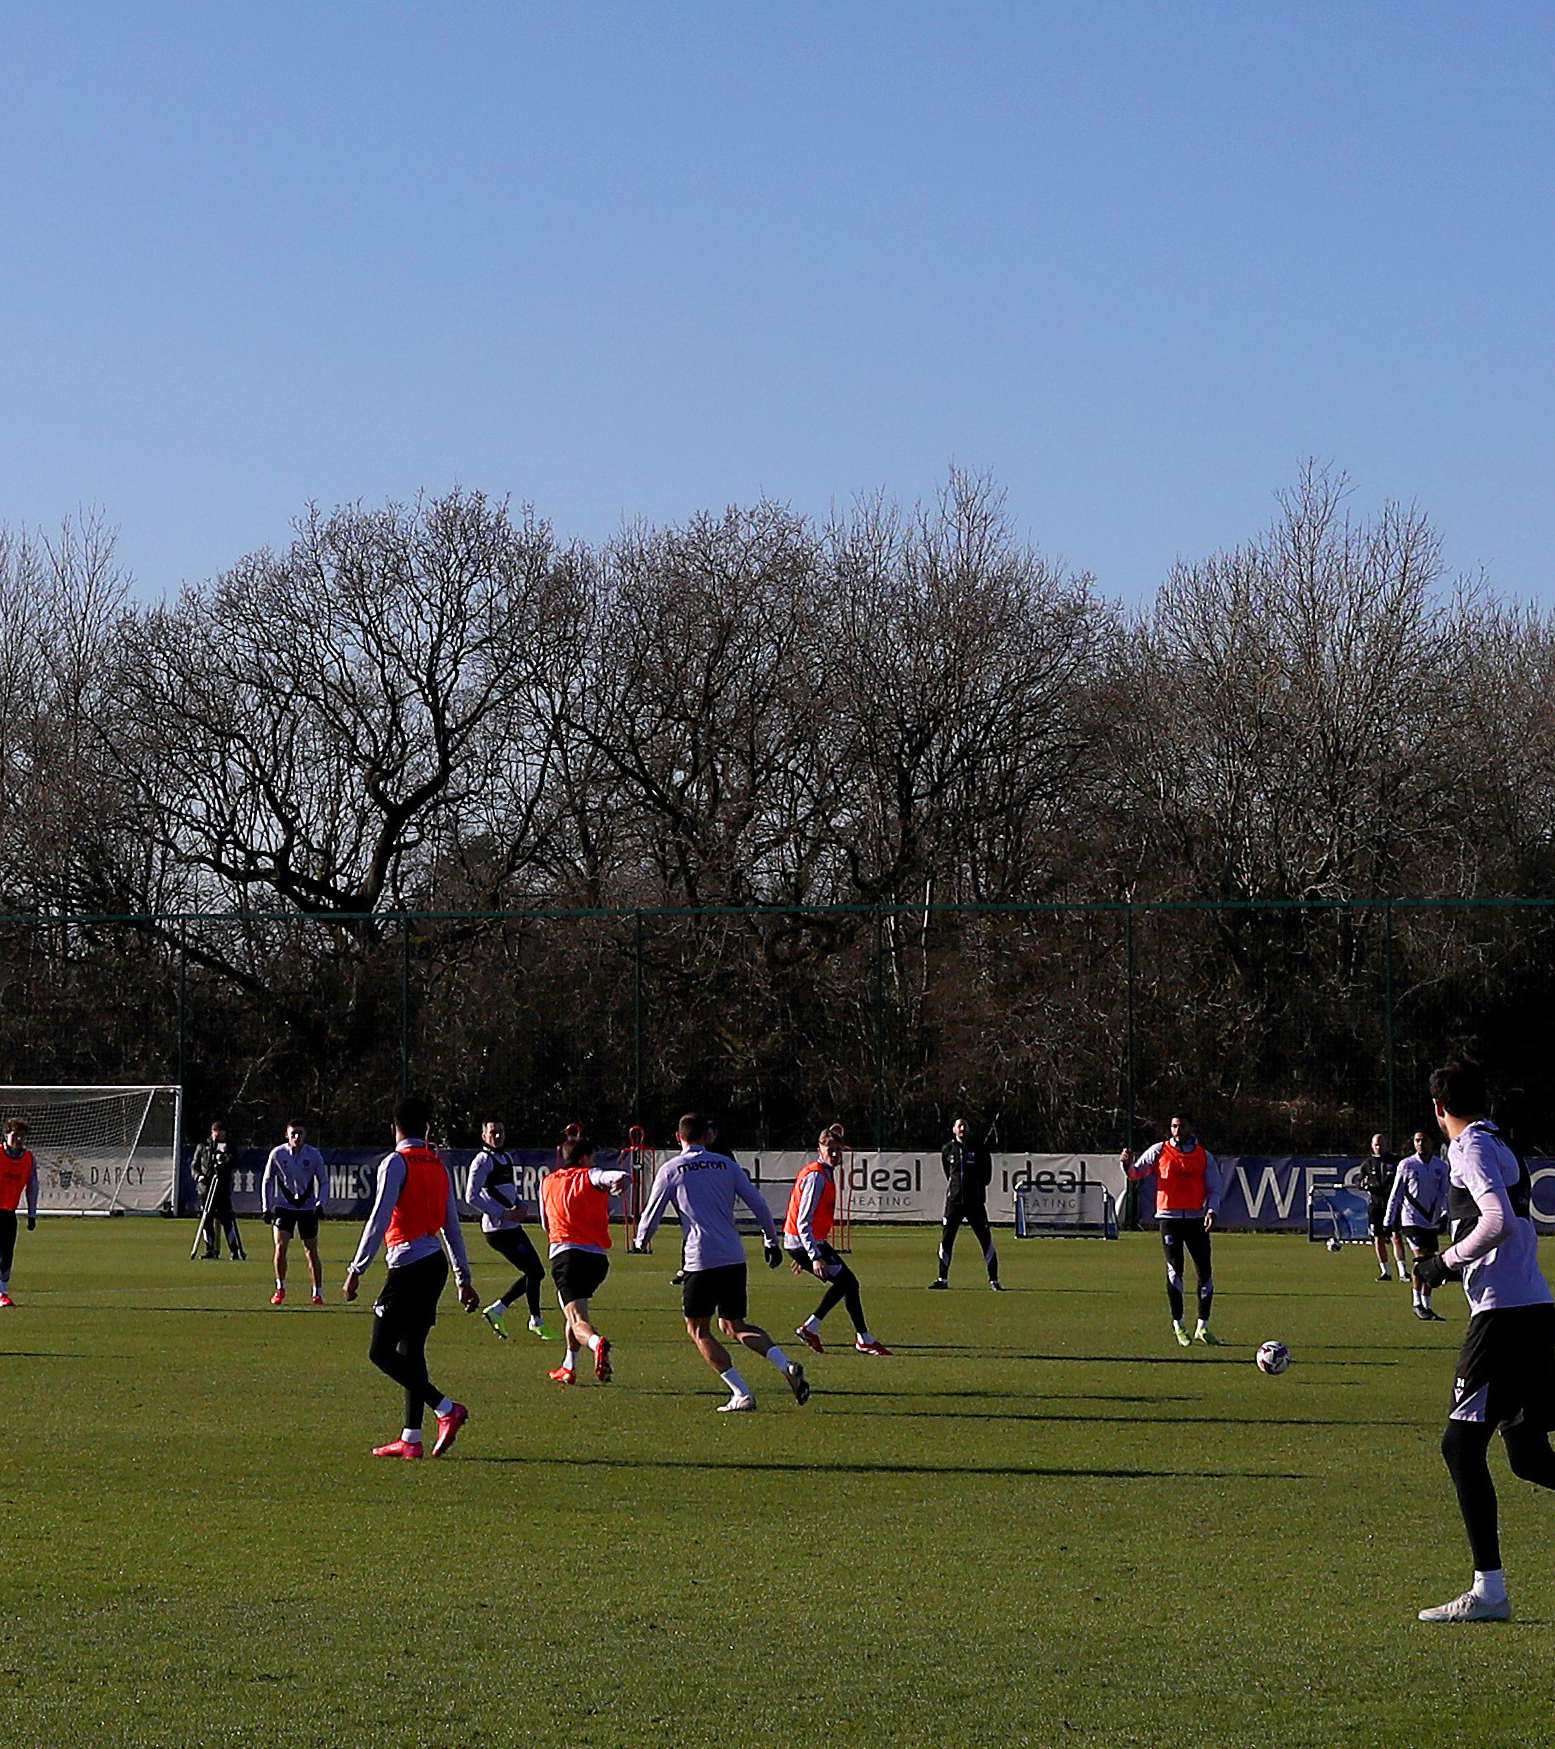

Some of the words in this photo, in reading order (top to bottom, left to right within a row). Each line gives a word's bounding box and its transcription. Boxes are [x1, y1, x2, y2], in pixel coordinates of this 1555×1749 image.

[677, 1159, 728, 1174] macron
[1002, 1159, 1087, 1194] ideal
[1023, 1198, 1077, 1209] EATING
